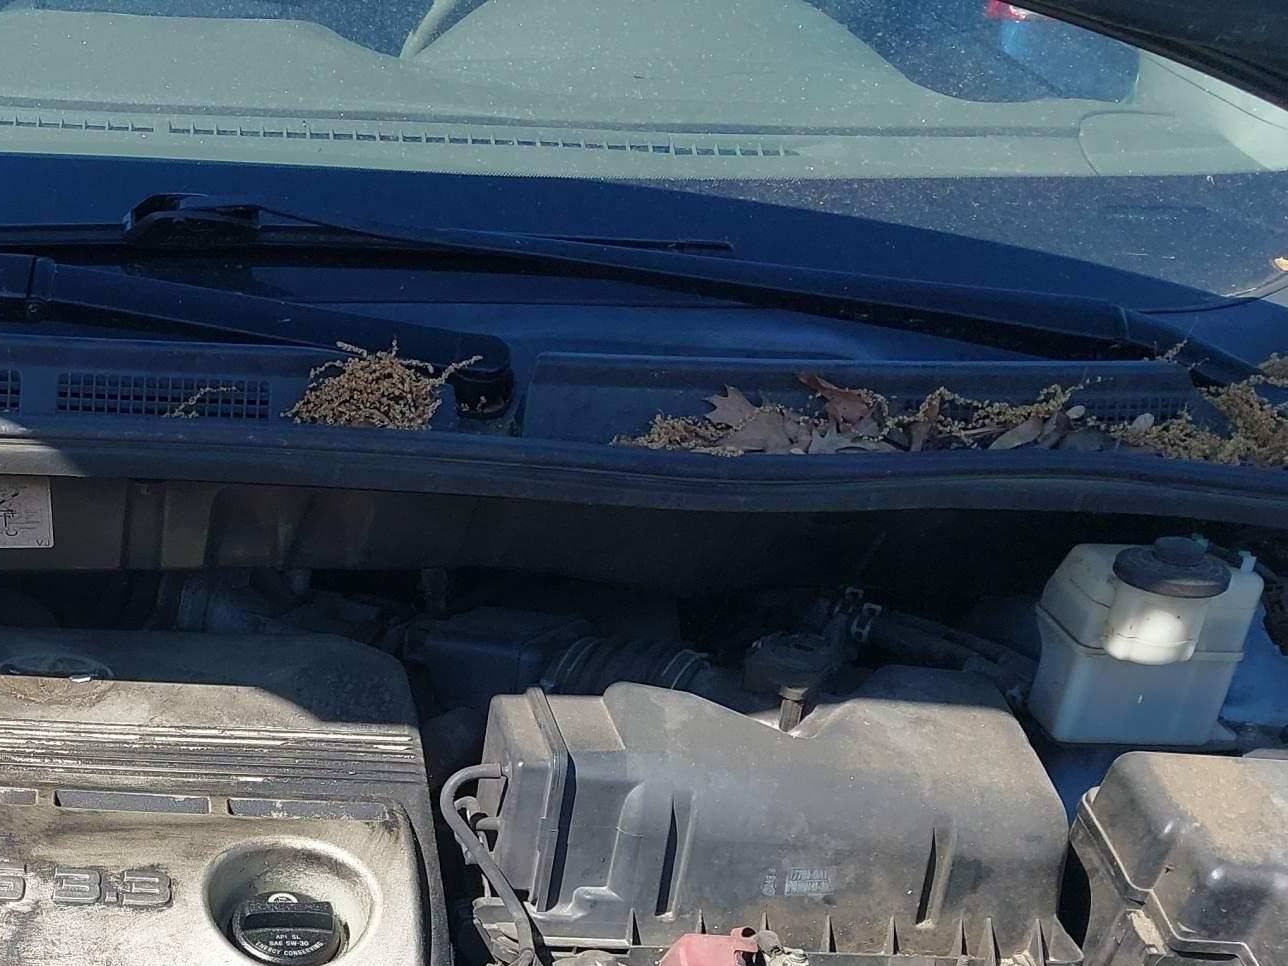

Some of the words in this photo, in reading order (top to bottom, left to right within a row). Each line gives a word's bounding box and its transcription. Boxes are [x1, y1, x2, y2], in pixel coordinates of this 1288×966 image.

[52, 866, 176, 907] 3.3
[255, 941, 281, 955] ENERGY
[284, 941, 325, 957] CONSERVING
